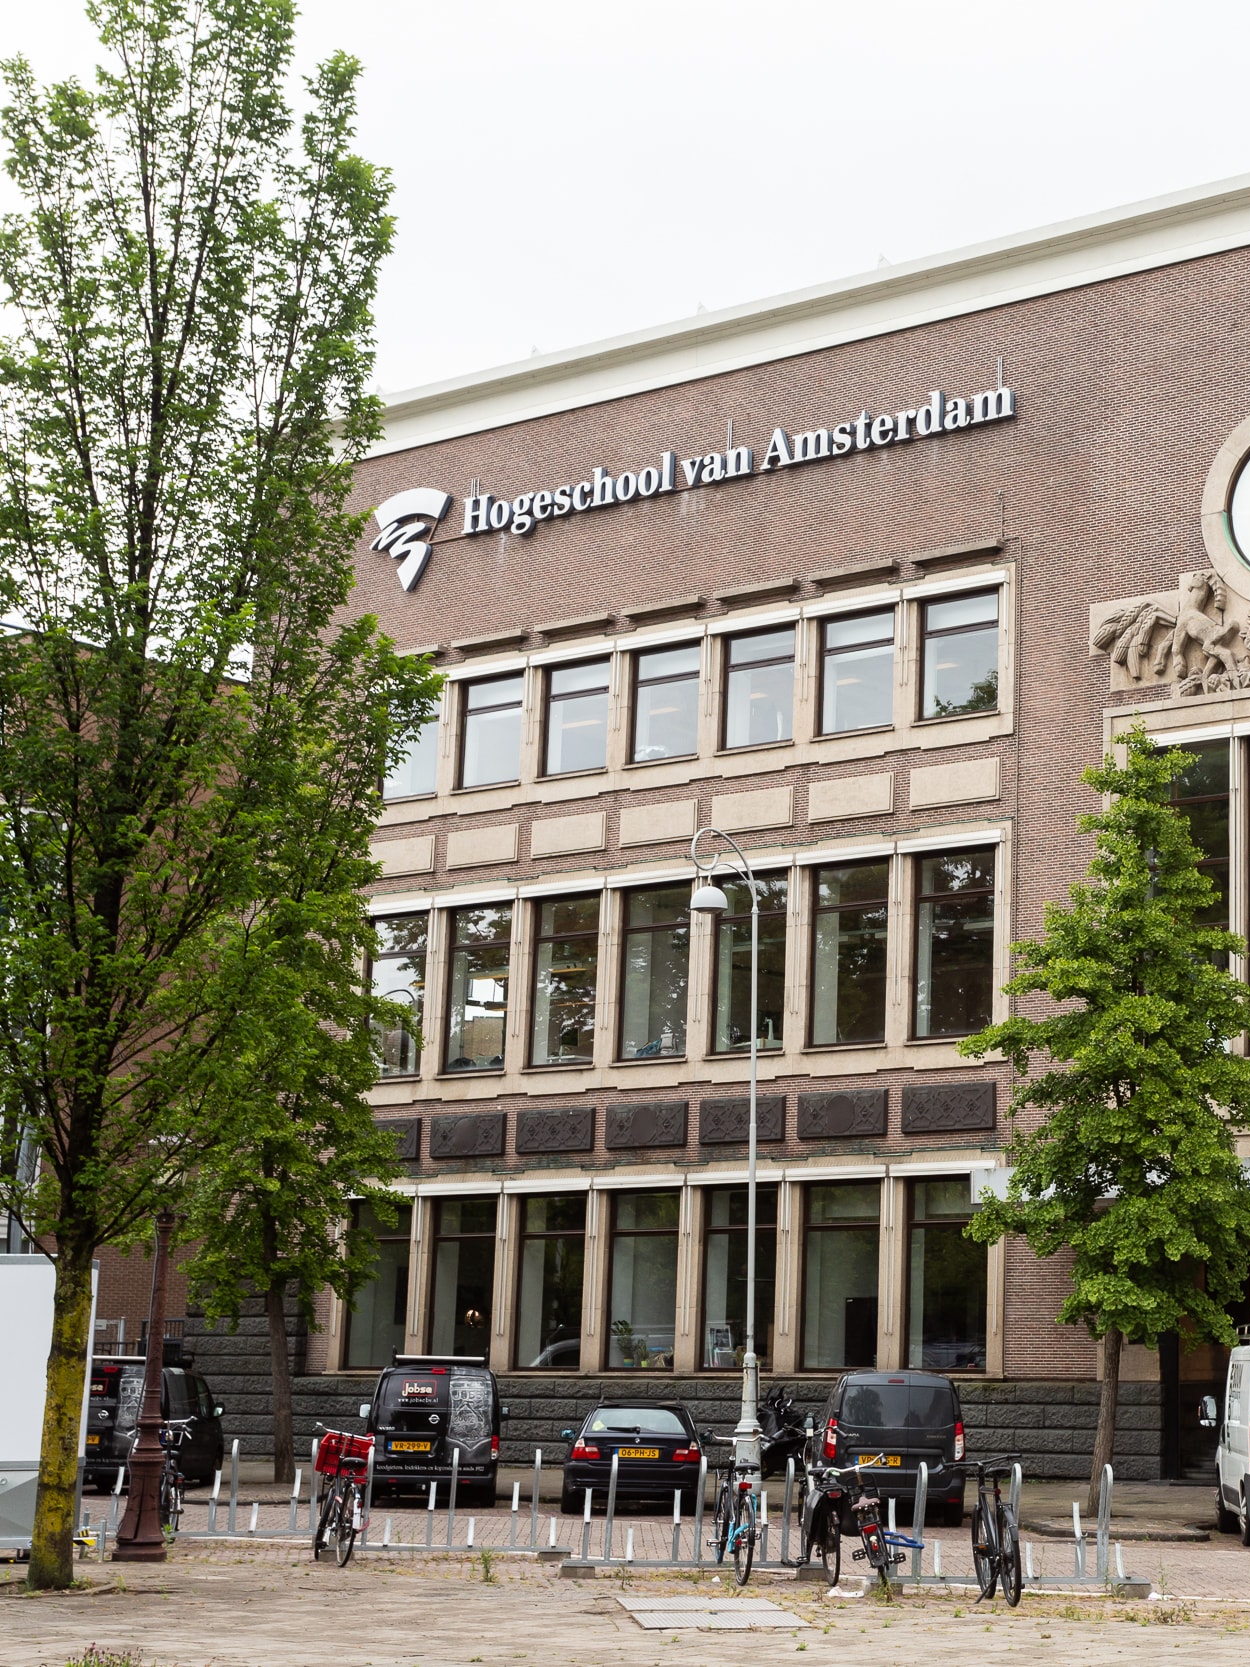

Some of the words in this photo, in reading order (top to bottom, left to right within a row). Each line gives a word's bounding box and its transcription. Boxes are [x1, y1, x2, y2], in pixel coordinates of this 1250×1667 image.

[461, 451, 677, 536] Hogeschool
[681, 446, 754, 486] van
[761, 386, 1016, 470] Amsterdam
[621, 1449, 657, 1457] 06-PH-JS
